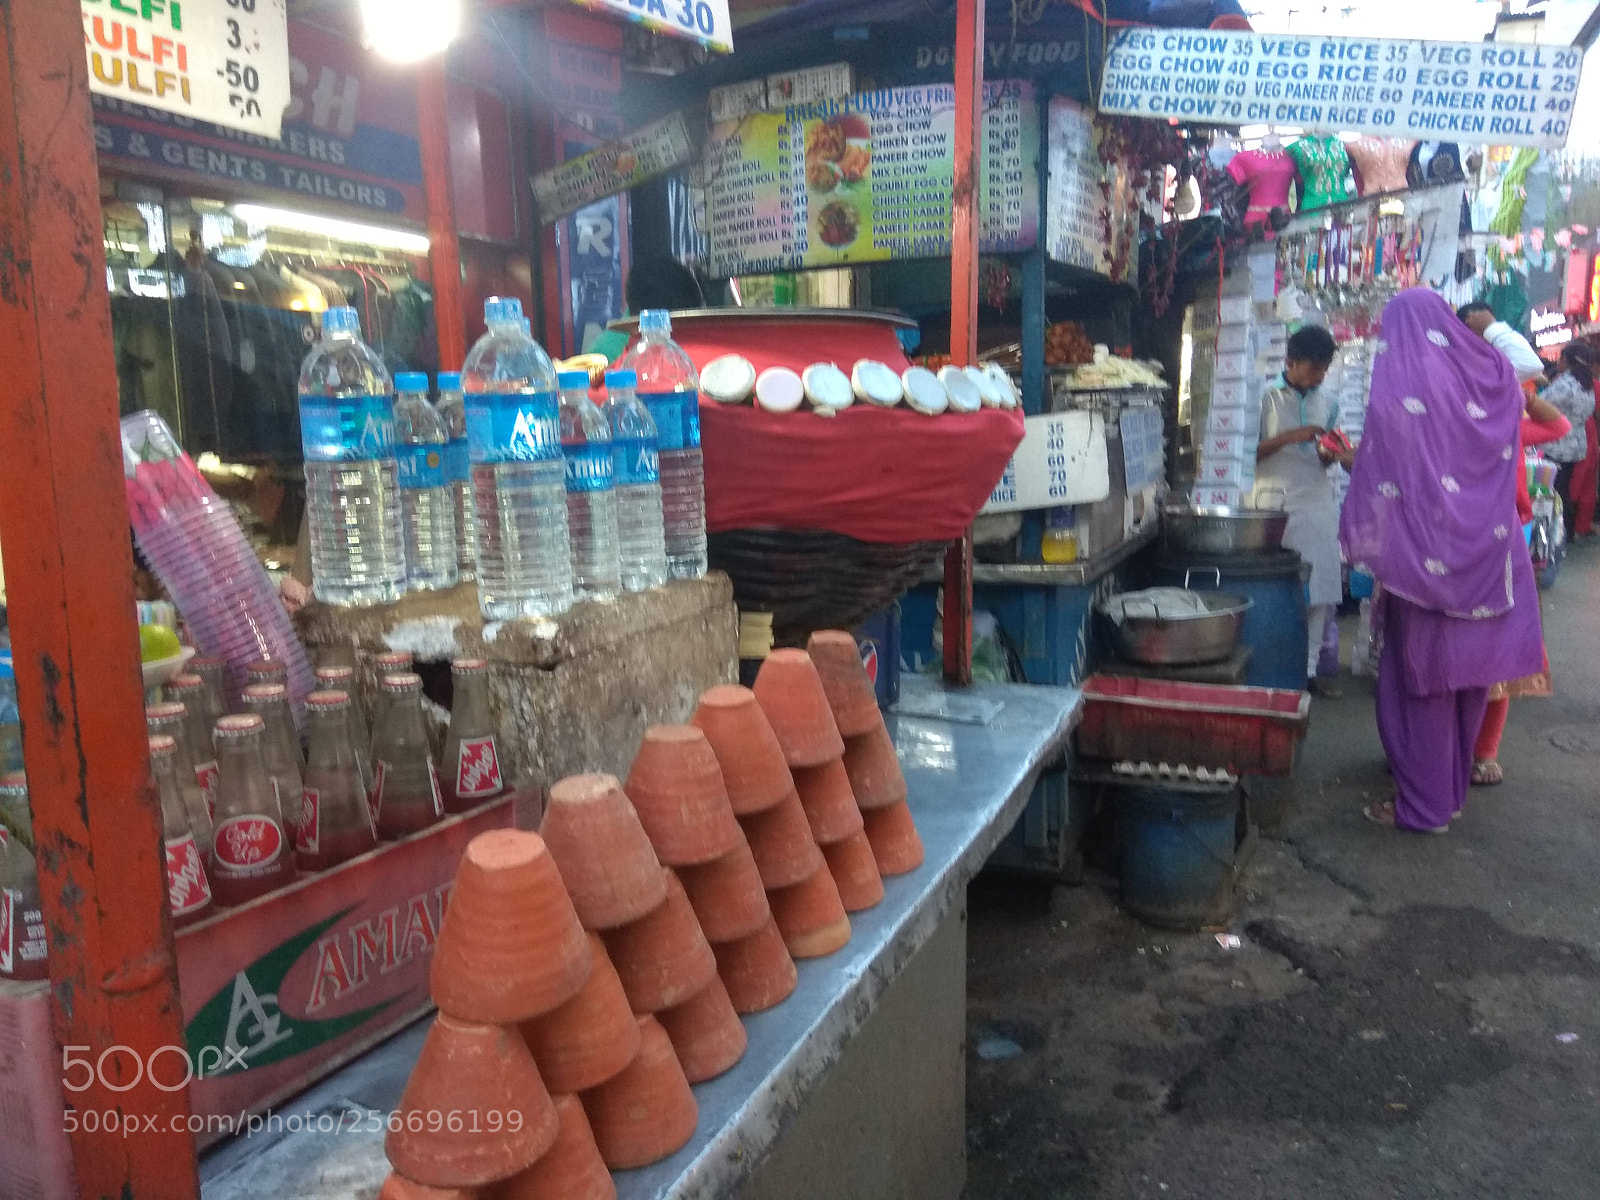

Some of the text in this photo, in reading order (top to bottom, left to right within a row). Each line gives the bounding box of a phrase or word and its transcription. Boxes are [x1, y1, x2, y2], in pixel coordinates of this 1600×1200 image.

[677, 0, 714, 35] 30
[83, 13, 187, 72] ULFI
[1009, 40, 1081, 65] FOOD
[1111, 33, 1578, 70] VEG CHOW 35 VEG RICE 35 VEG ROLL 20
[92, 52, 190, 105] ULFI
[1109, 53, 1576, 92] EGG CHOW 40 EGG RICE 40 EGG ROLL 25
[895, 89, 922, 106] VEG
[1105, 74, 1571, 113] CHICKEN CHOW 60 VEG PANEER RICE 60 PANEER ROLL 40
[897, 105, 932, 119] CHOW
[1102, 92, 1566, 137] MIX CHOW 70 CHCKEN RICE 60 CHICKEN ROLL 40
[870, 125, 893, 136] EGG
[897, 120, 931, 132] CHOW
[1004, 114, 1018, 124] 40
[871, 135, 909, 150] CHIKEN
[912, 132, 946, 147] CHOW
[871, 150, 908, 164] PANEER
[912, 148, 946, 160] CHOW
[128, 131, 151, 158] &
[279, 167, 388, 208] TAILORS
[742, 159, 760, 174] ROLL
[872, 168, 890, 179] MIX
[894, 164, 927, 176] CHOW
[756, 170, 775, 185] ROLL
[872, 178, 911, 193] DOUBLE
[914, 177, 938, 189] EGG
[872, 193, 910, 208] CHIKEN
[913, 192, 945, 205] KABAB
[737, 205, 754, 217] ROLL
[872, 208, 910, 222] CHIKEN
[913, 206, 945, 219] KABAB
[757, 216, 777, 229] ROLL
[873, 222, 910, 236] PANEER
[913, 220, 945, 232] KABAB
[759, 229, 779, 243] ROLL
[1049, 469, 1067, 483] 70
